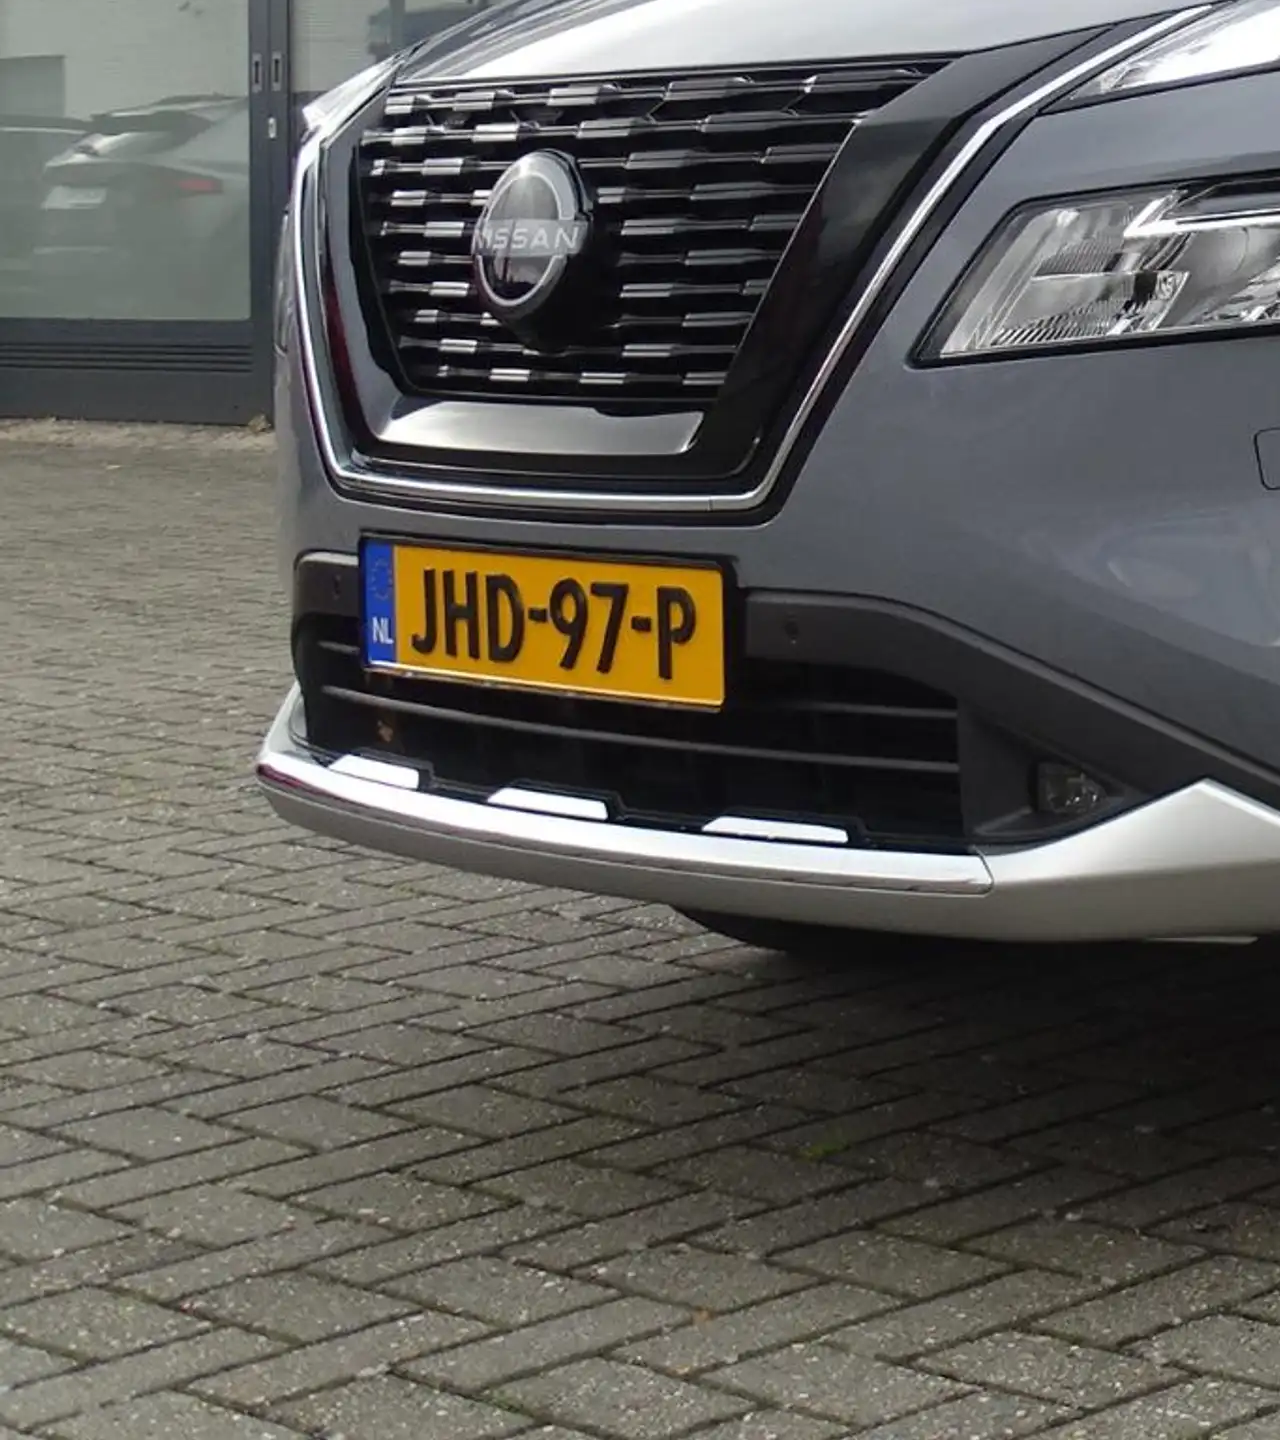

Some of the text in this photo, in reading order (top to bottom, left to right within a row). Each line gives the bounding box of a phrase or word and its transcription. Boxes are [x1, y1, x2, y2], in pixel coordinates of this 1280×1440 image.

[472, 226, 580, 250] NISSAN
[372, 616, 394, 644] NL
[411, 568, 697, 680] JHD-97-P
